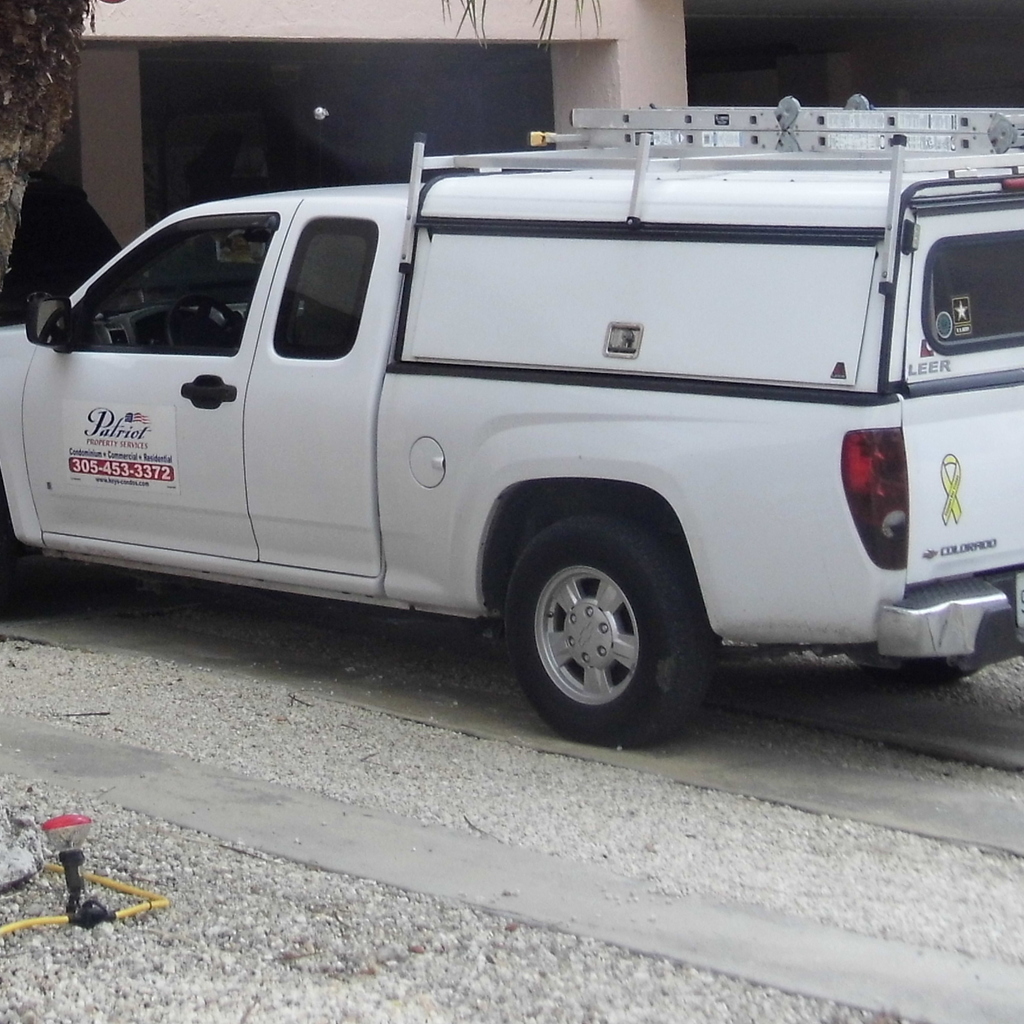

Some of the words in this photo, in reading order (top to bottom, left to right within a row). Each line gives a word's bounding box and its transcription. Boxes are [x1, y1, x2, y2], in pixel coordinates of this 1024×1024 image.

[908, 360, 951, 376] LEER
[84, 407, 152, 440] Patriot
[86, 438, 118, 447] PROPERTY
[120, 440, 149, 450] SERVICES
[69, 447, 102, 457] Condominium
[107, 451, 138, 461] Commercial
[144, 453, 172, 463] Residential
[72, 458, 171, 480] 305-453-3372
[941, 539, 997, 556] COLORADO
